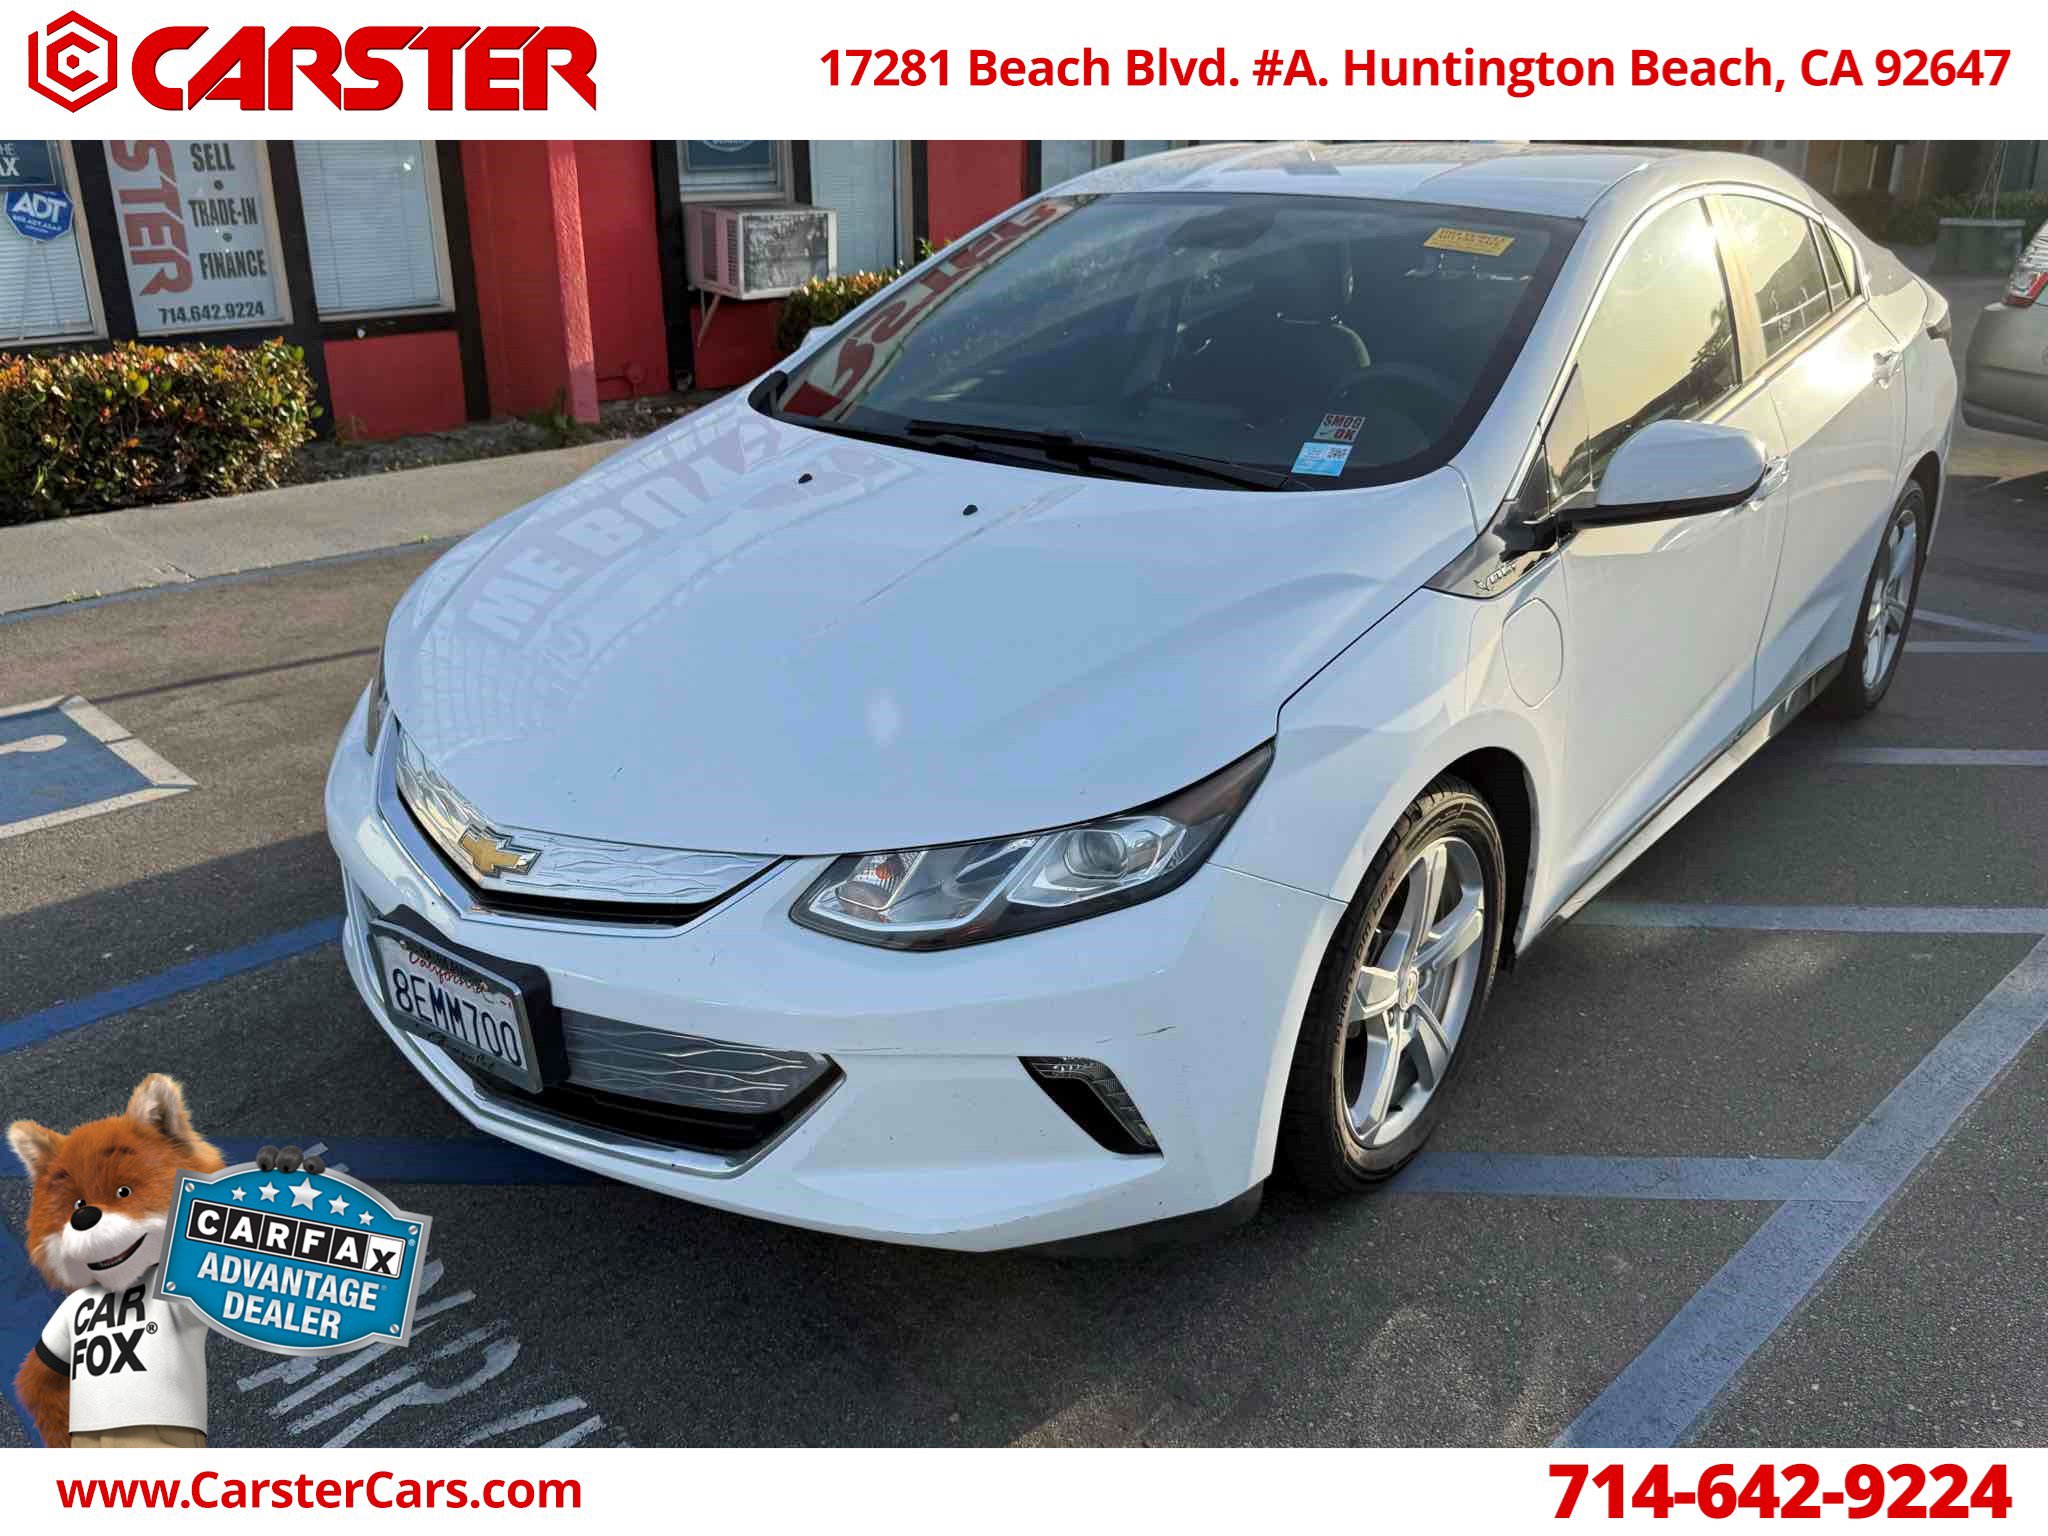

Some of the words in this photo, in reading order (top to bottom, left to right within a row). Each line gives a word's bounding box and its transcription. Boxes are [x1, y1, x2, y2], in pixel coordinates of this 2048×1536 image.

[190, 143, 235, 172] SELL
[12, 191, 68, 223] ADT
[188, 197, 258, 228] TRADE-IN
[200, 250, 267, 281] FINANCE
[158, 301, 265, 326] 714.642.9224
[393, 968, 522, 1067] 8EMM700
